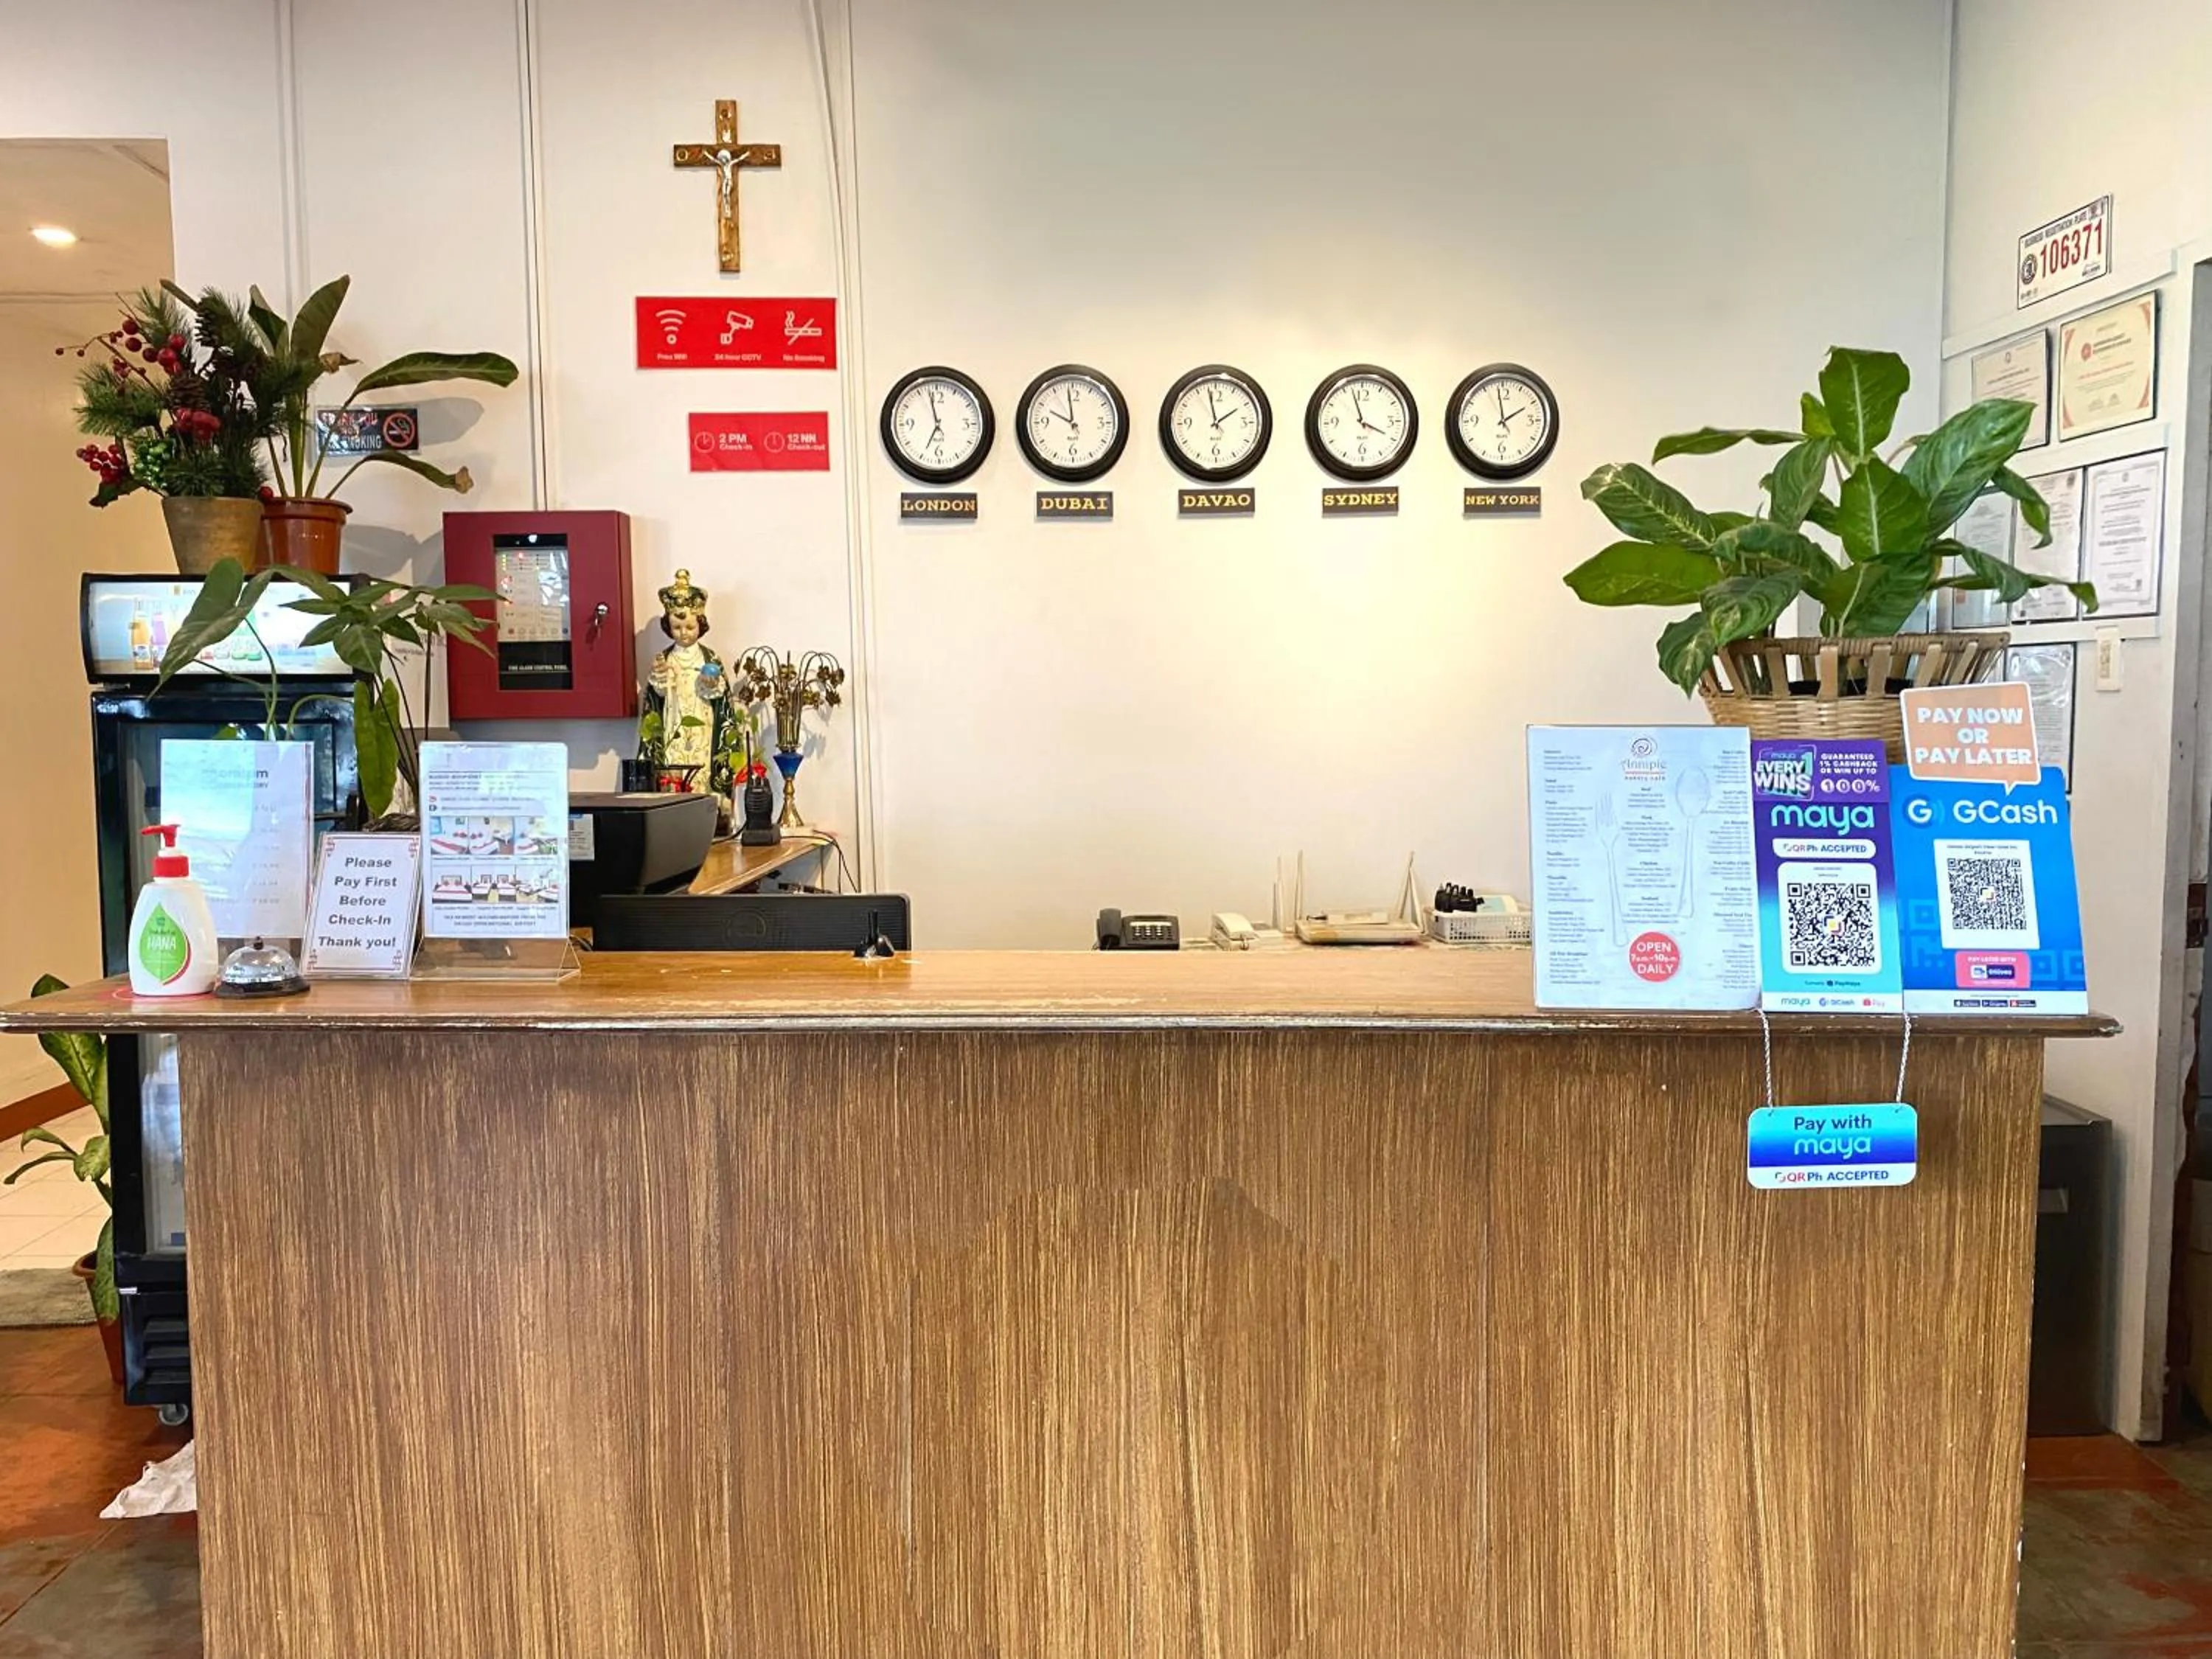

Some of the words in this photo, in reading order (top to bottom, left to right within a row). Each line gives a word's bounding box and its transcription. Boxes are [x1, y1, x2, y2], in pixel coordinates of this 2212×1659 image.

[2040, 218, 2102, 279] 106371
[1357, 389, 1369, 401] 12
[719, 433, 726, 443] 2
[728, 433, 747, 443] PM
[787, 433, 799, 443] 12
[801, 433, 817, 443] NN
[902, 499, 976, 512] LONDON
[1040, 497, 1108, 509] DUBAI
[1183, 494, 1251, 507] DAVAO
[1324, 492, 1398, 507] SYDNEY
[1465, 495, 1498, 506] NEW
[1498, 494, 1540, 506] YORK
[1917, 708, 1963, 723] PAY
[1967, 708, 2023, 724] NOW
[1958, 728, 1989, 743] OR
[1915, 748, 1961, 764] PAY
[1965, 748, 2031, 765] LATER
[1756, 760, 1805, 773] EVERY
[1753, 771, 1812, 792] WINS
[1953, 799, 2058, 824] GCash
[1771, 804, 1874, 836] maya
[1821, 844, 1867, 853] ACCEPTED
[345, 858, 392, 868] Please
[335, 876, 360, 888] Pay
[365, 877, 397, 887] First
[339, 895, 386, 906] Before
[329, 914, 391, 925] Check-In
[319, 936, 361, 947] Thank
[366, 936, 396, 949] you!
[1637, 942, 1672, 952] OPEN
[1638, 964, 1673, 973] DAILY
[1781, 998, 1810, 1006] maya
[1794, 1117, 1826, 1134] Pay
[1832, 1114, 1871, 1129] with
[1794, 1137, 1871, 1160] maya
[1828, 1170, 1888, 1181] ACCEPTED
